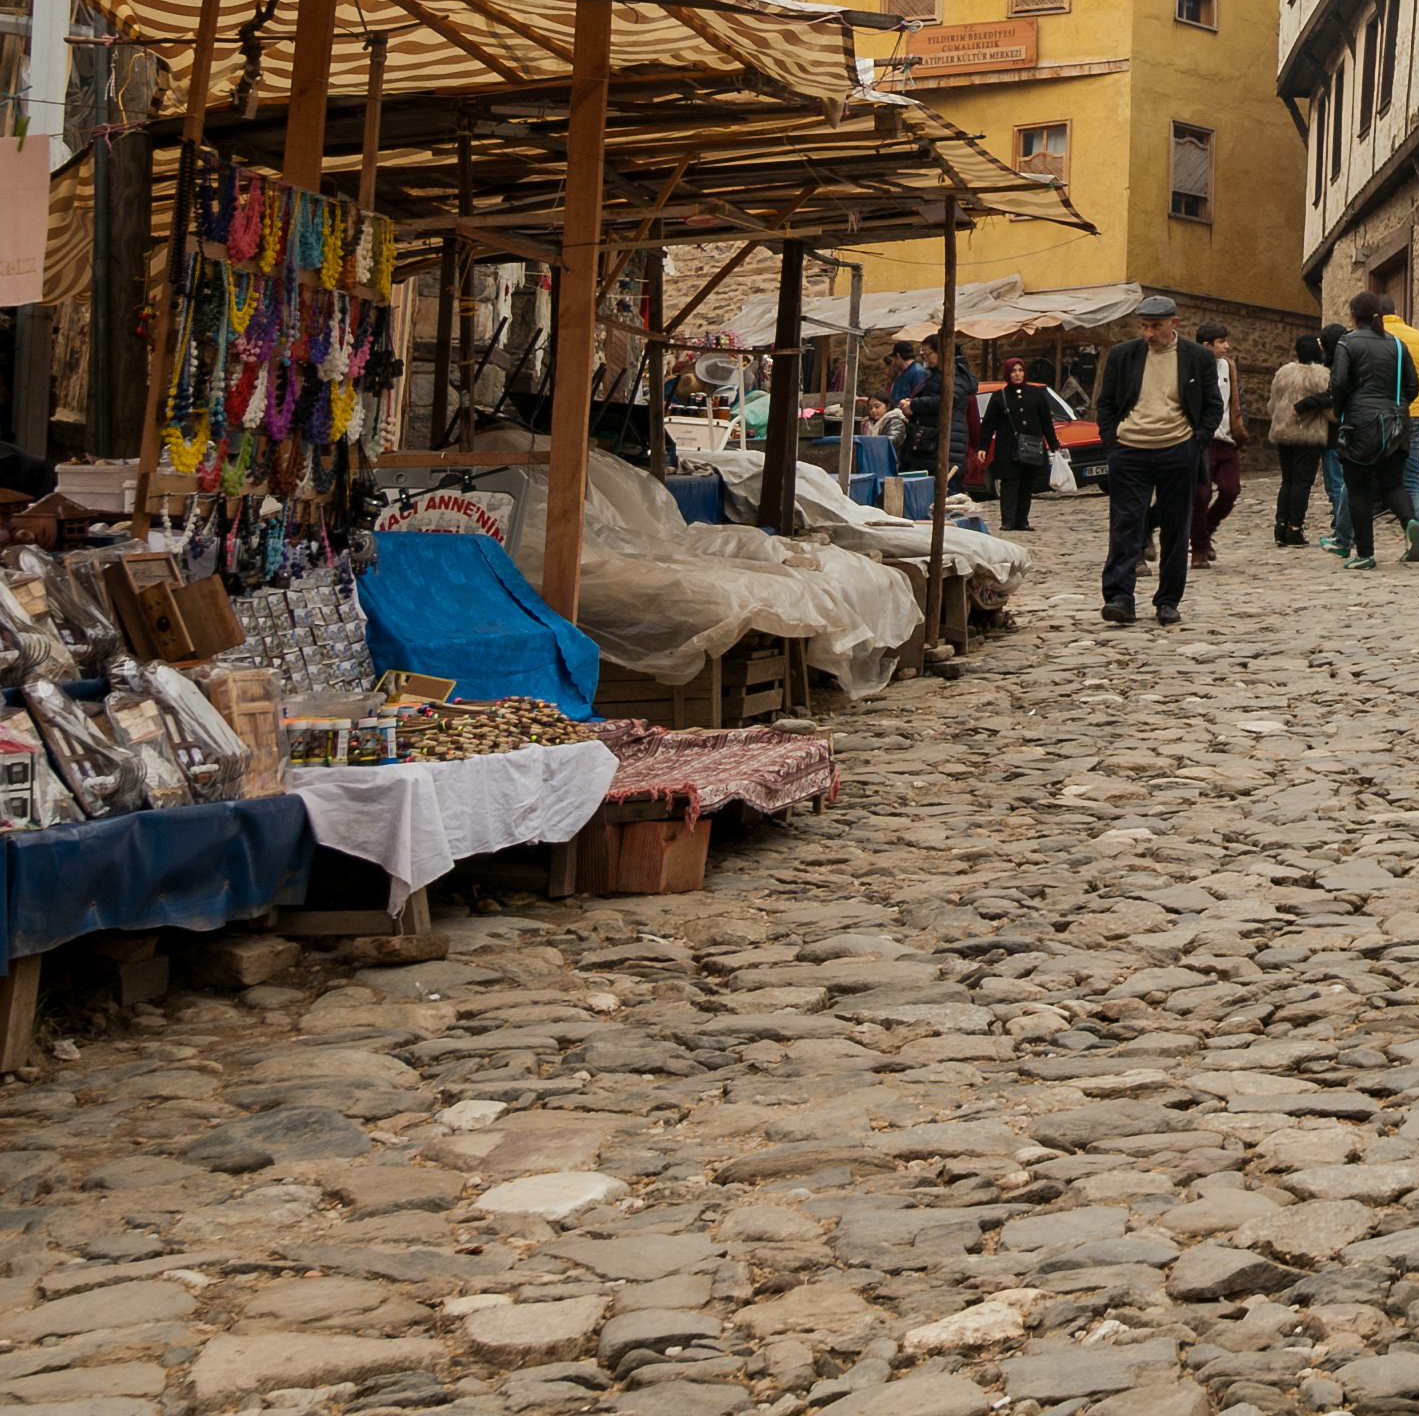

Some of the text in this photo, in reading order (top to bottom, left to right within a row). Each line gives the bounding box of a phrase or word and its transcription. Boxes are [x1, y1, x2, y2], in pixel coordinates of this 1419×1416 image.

[928, 28, 1016, 45] YILDIRIM BELEDİYESİ
[941, 40, 1000, 52] CUMALIKIZIK
[956, 51, 987, 63] KÜLTÜR
[989, 49, 1022, 60] MERKEZİ
[379, 501, 417, 532] ACI
